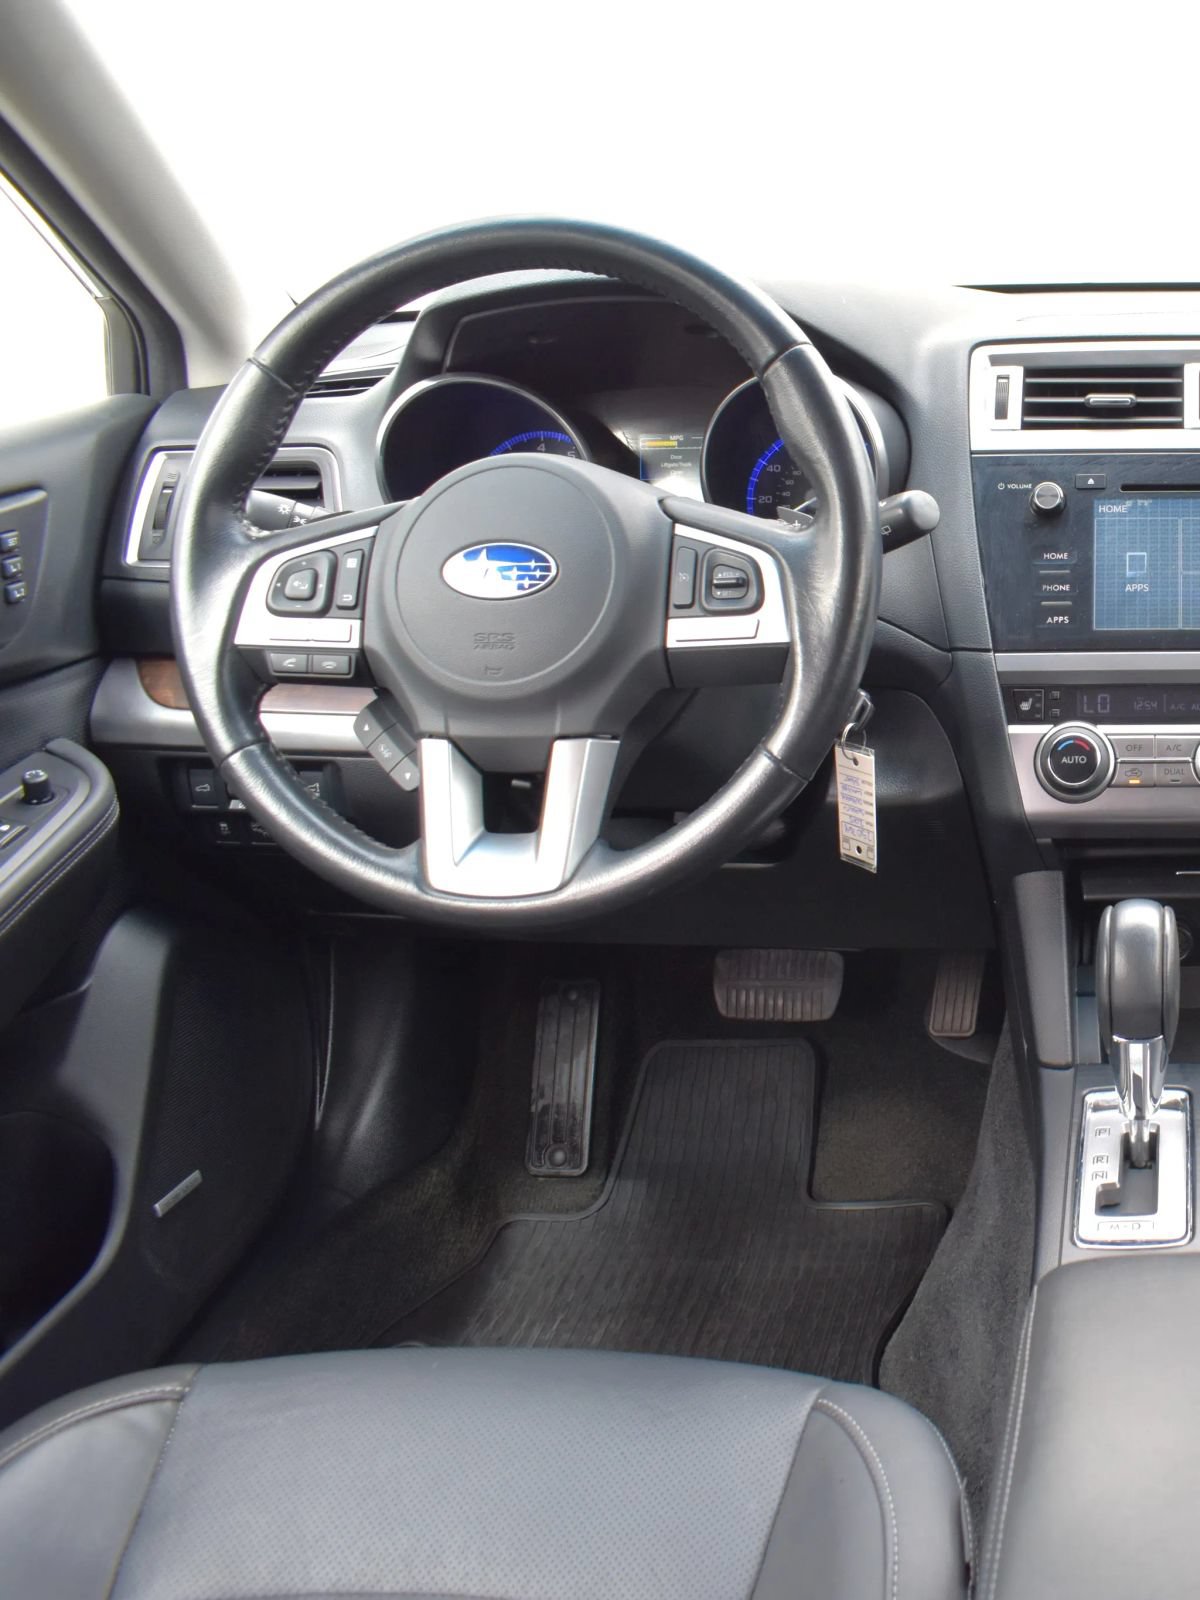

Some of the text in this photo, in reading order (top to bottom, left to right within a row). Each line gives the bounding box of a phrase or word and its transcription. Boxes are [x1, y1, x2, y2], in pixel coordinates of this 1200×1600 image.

[537, 443, 546, 452] 4
[567, 451, 576, 459] 5
[766, 464, 781, 473] 40
[758, 495, 773, 504] 20
[1098, 504, 1128, 513] HOME
[1043, 552, 1069, 560] HOME
[1042, 584, 1071, 592] PHONE
[1125, 583, 1149, 593] APPS
[1046, 616, 1070, 624] APPS
[1125, 744, 1143, 752] OFF
[1166, 744, 1182, 752] A/C
[1061, 755, 1087, 764] AUTO
[1164, 768, 1184, 776] DUAL
